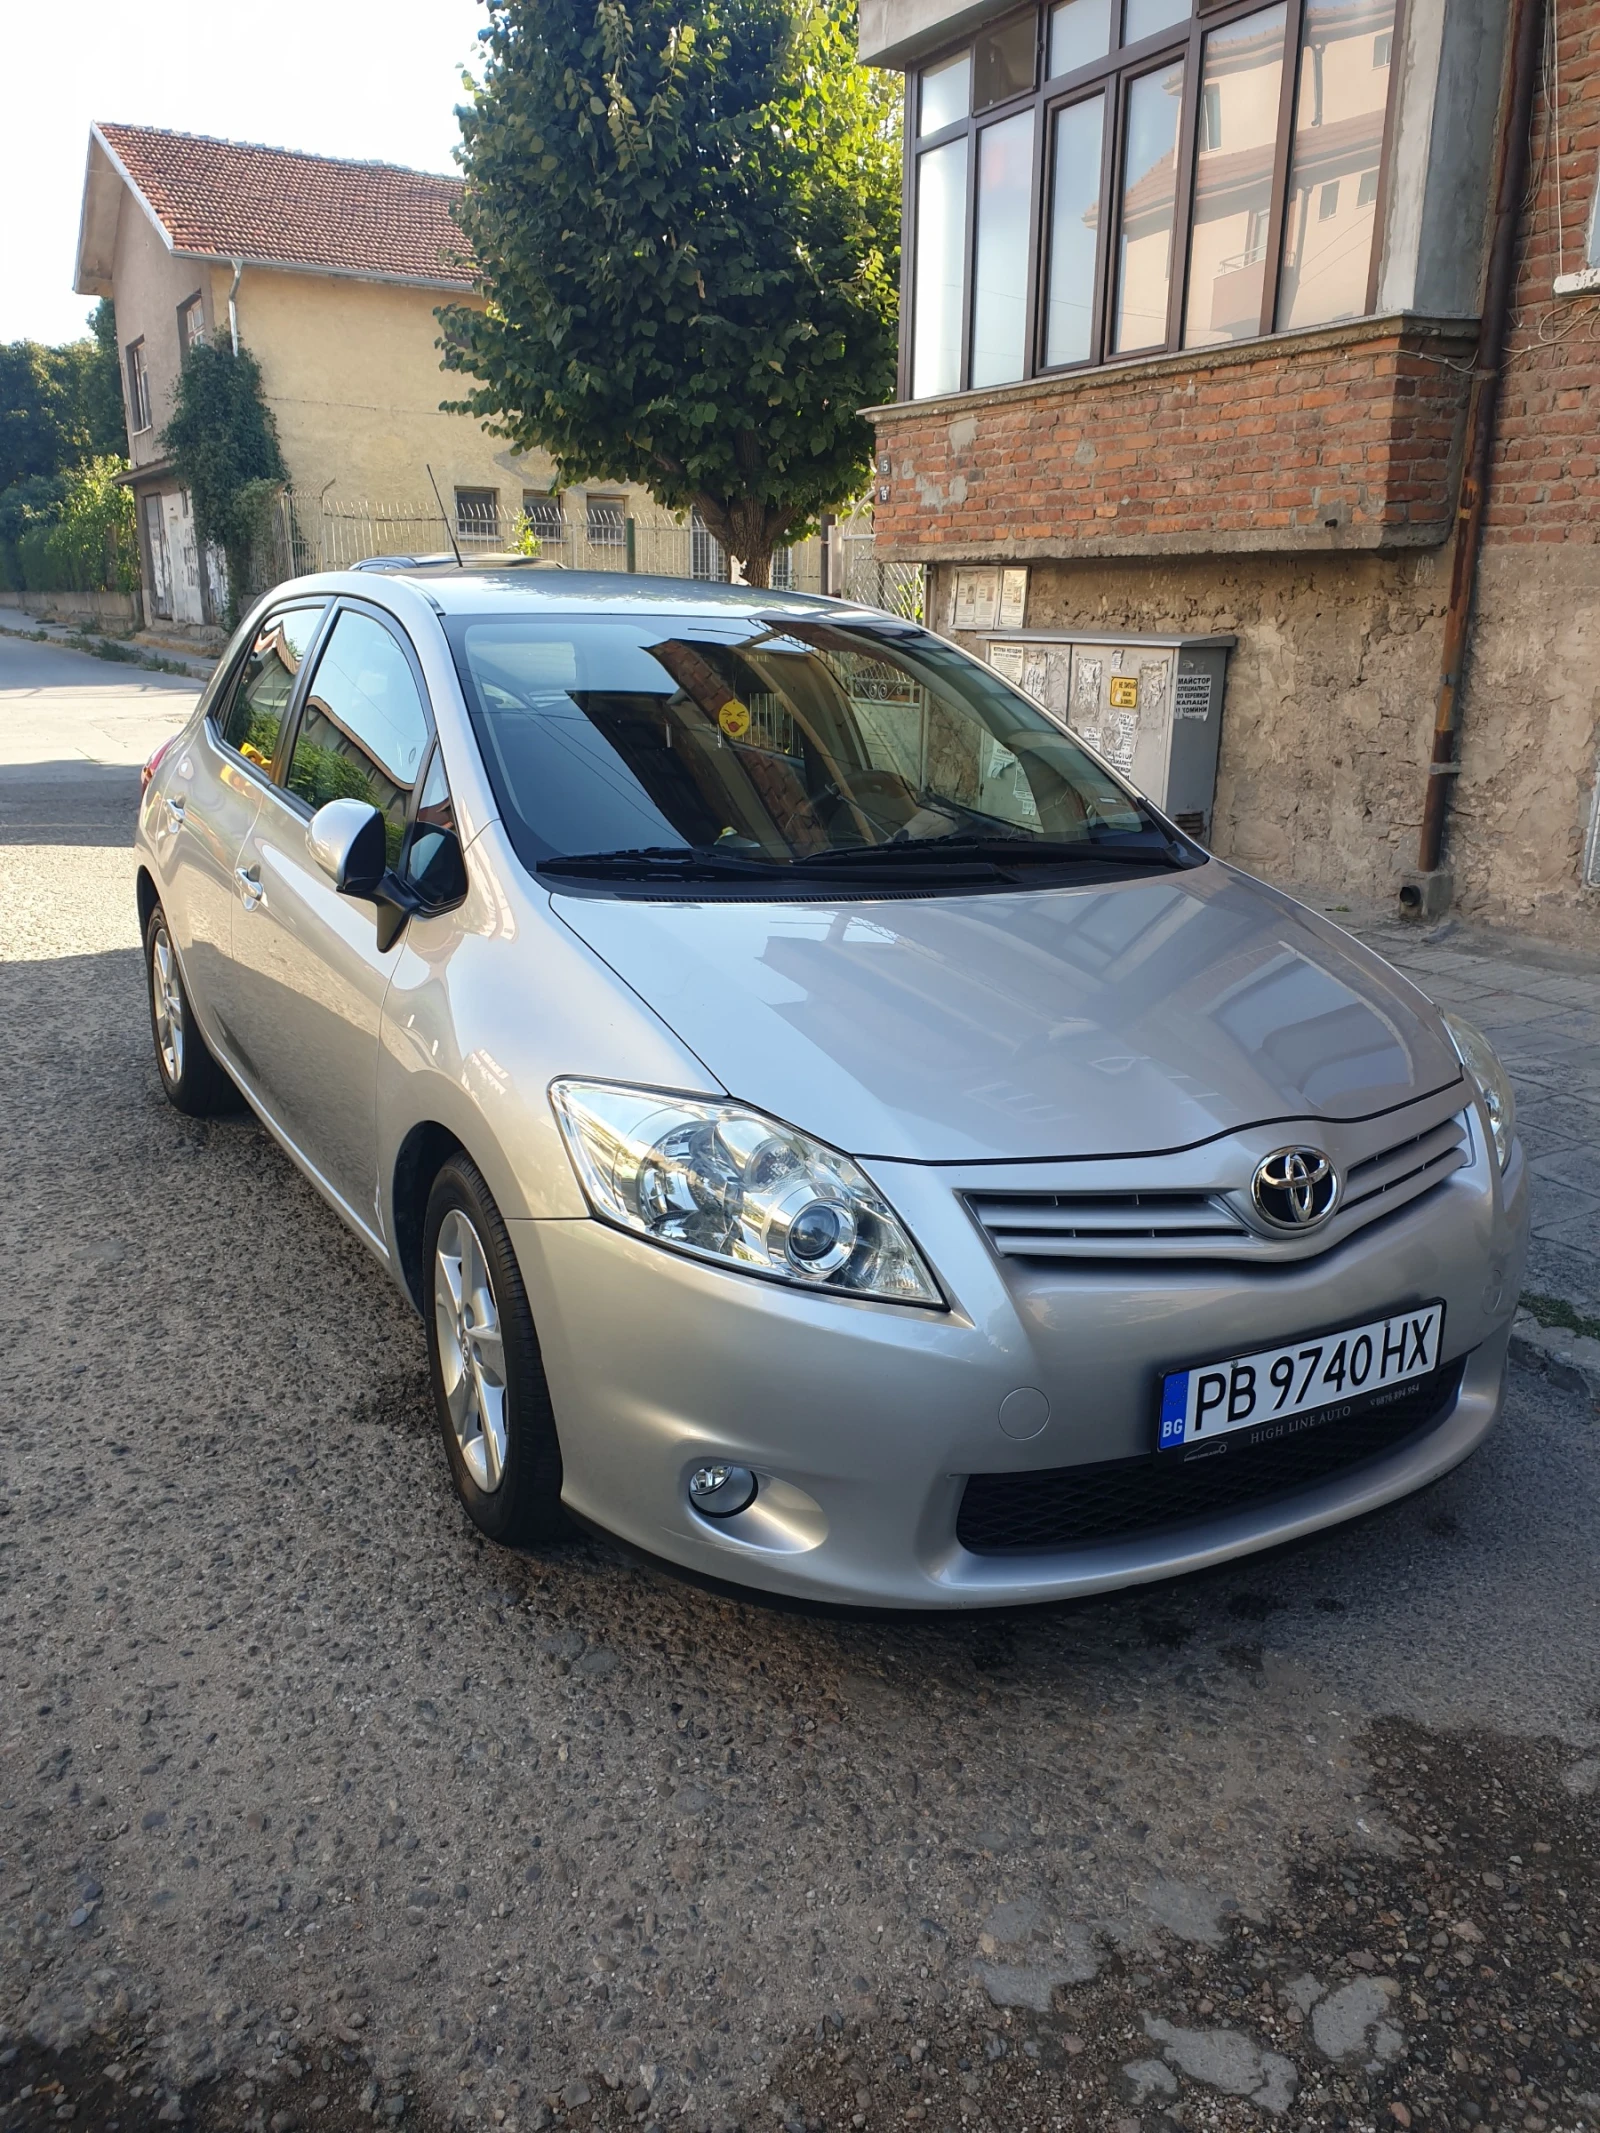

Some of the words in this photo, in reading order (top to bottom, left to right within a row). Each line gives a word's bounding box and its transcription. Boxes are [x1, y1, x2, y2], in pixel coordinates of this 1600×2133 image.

[1178, 677, 1210, 685] МАЙСТОР
[1194, 1365, 1257, 1431] PB
[1269, 1334, 1373, 1410] 9740
[1379, 1314, 1434, 1379] HX
[1162, 1418, 1183, 1438] BG
[1250, 1425, 1284, 1444] HIGH
[1288, 1415, 1316, 1433] LINE
[1319, 1405, 1351, 1424] AUTO
